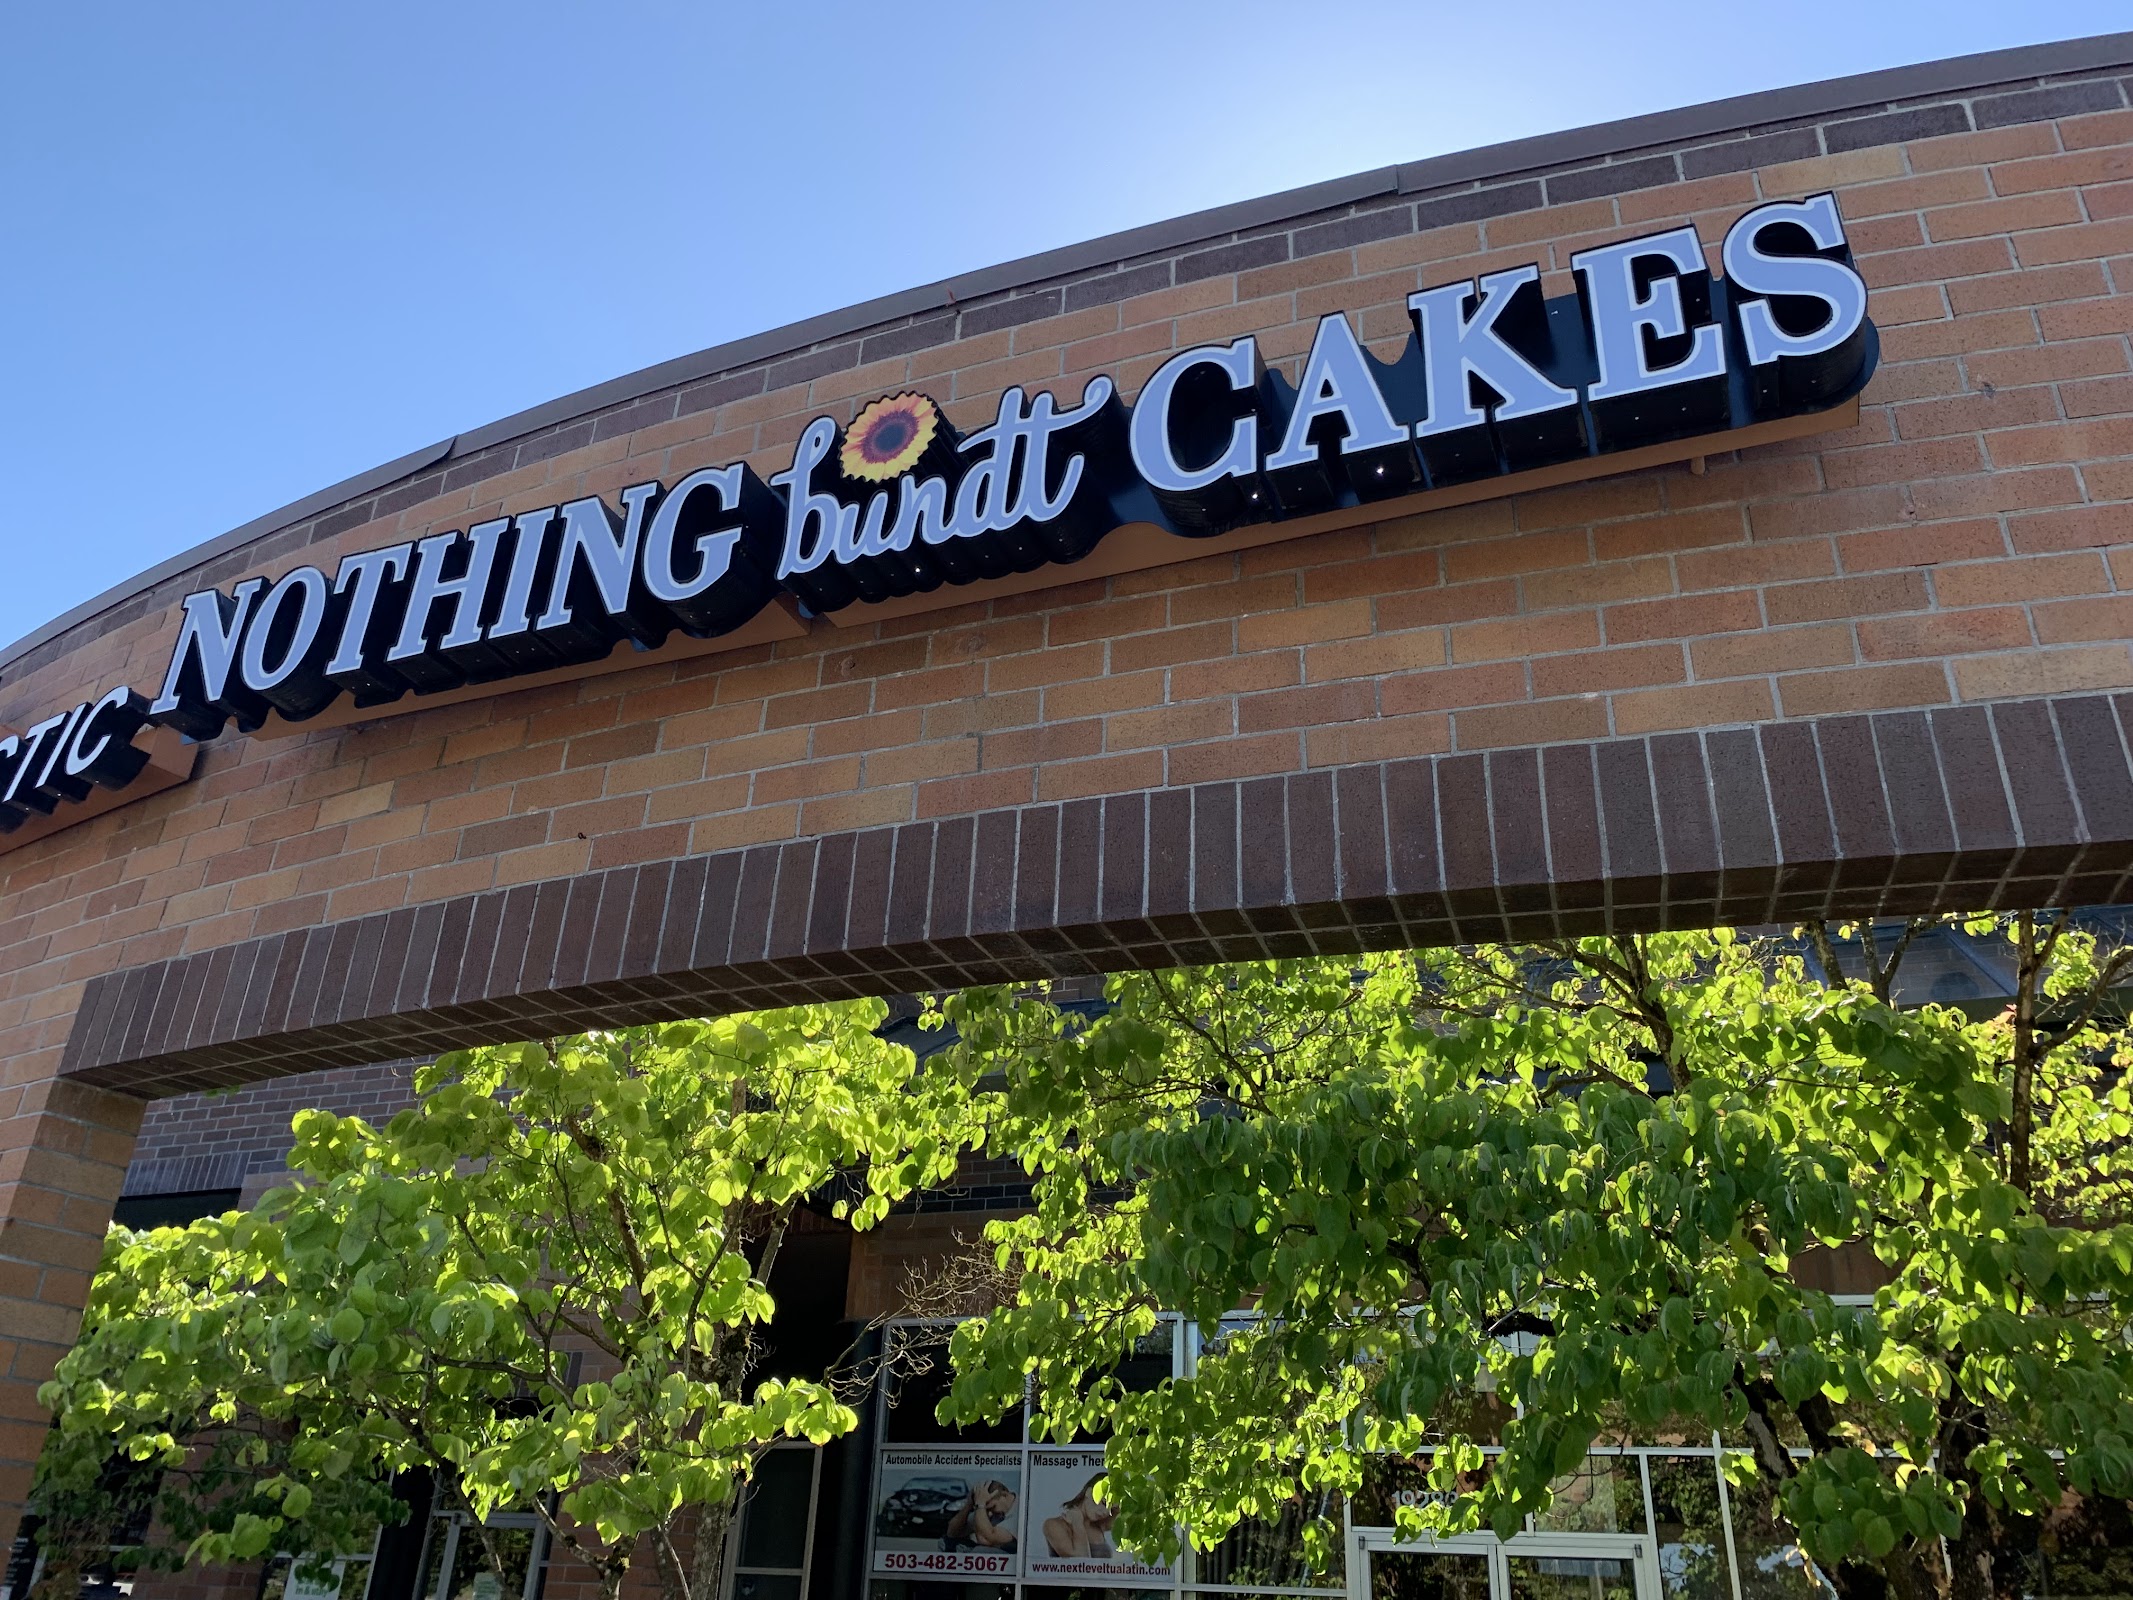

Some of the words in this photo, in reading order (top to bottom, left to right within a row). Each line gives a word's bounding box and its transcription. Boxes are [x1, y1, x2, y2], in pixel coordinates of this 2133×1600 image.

[149, 462, 746, 716] NOTHING
[769, 373, 1114, 580] bundt
[1130, 191, 1868, 492] CAKES
[885, 1454, 933, 1465] Automobile
[934, 1454, 972, 1465] Accident
[974, 1454, 1022, 1467] Specialists
[1033, 1455, 1079, 1468] Massage
[1081, 1455, 1104, 1466] Ther
[884, 1553, 1010, 1572] 503-482-5067
[1032, 1562, 1171, 1576] www.nextleveltualatin.com
